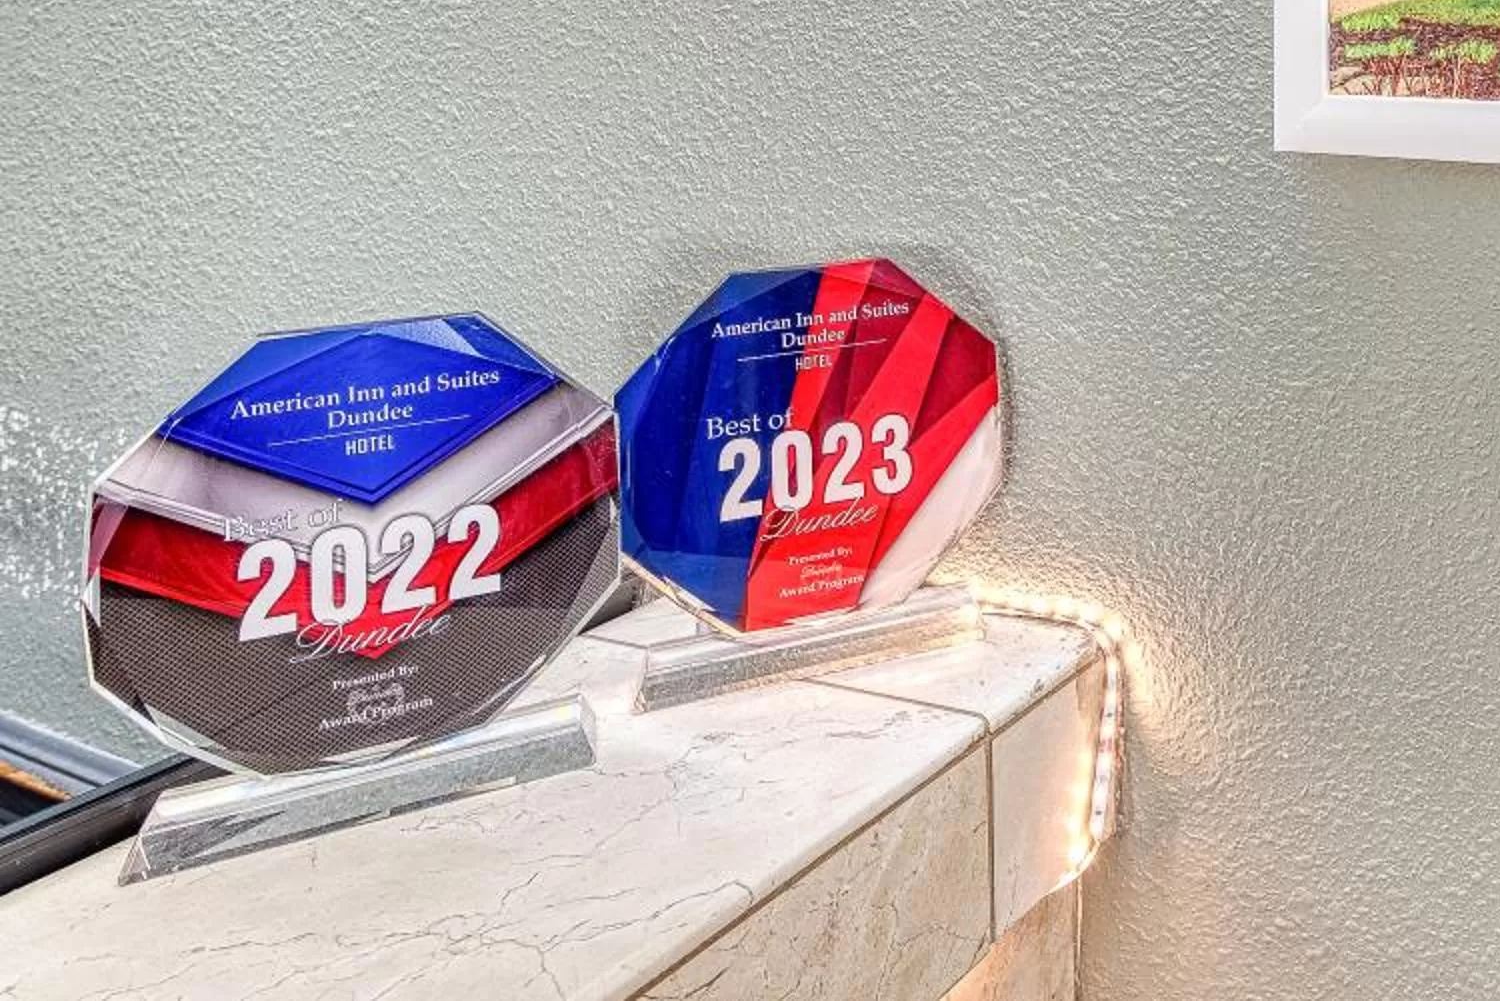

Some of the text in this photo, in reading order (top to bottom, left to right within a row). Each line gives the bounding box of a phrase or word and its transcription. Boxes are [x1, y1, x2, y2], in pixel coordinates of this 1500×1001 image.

[711, 300, 910, 339] American Inn and Suites
[781, 329, 845, 349] Dundee
[795, 354, 833, 372] HOTEL
[230, 369, 501, 420] American Inn and Suites
[327, 403, 413, 430] Dundee
[706, 407, 794, 440] Best of
[345, 434, 395, 456] HOTEL
[717, 412, 914, 524] 2023
[221, 499, 342, 542] Best of
[760, 495, 878, 542] Dundee
[237, 504, 502, 642] 2022
[289, 604, 451, 665] Dundee
